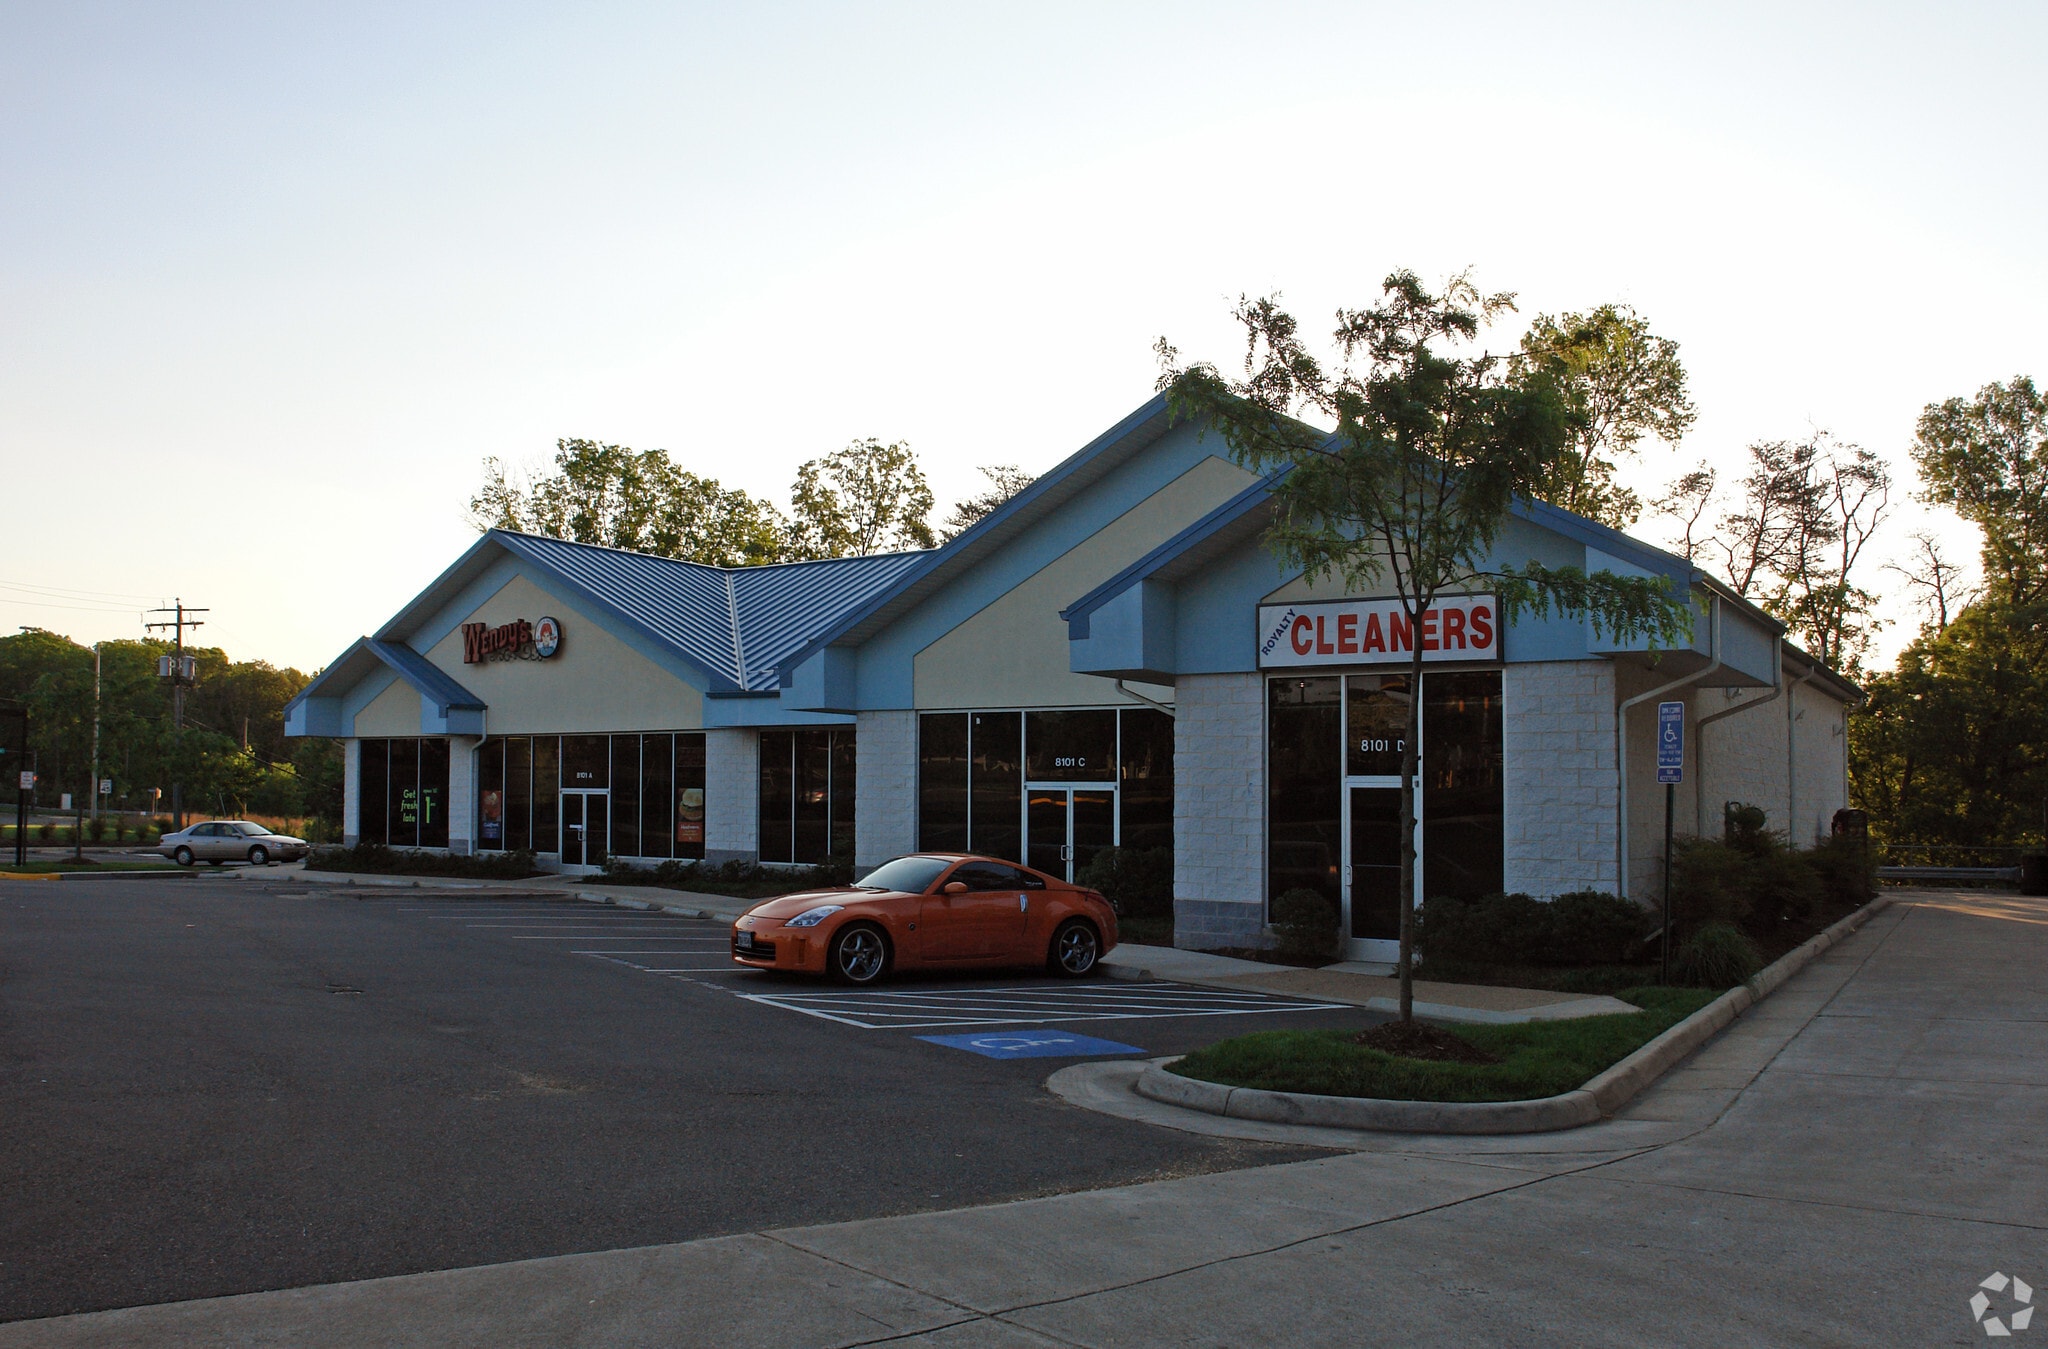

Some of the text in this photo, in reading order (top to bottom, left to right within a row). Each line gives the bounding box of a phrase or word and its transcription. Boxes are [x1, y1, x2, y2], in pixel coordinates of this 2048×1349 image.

[1261, 608, 1297, 656] ROYALTY
[1291, 606, 1493, 655] CLEANERS
[1361, 739, 1406, 752] 8101 D
[1055, 757, 1086, 767] 8101 C
[403, 788, 416, 799] Get
[400, 799, 418, 813] fresh
[403, 812, 416, 823] late
